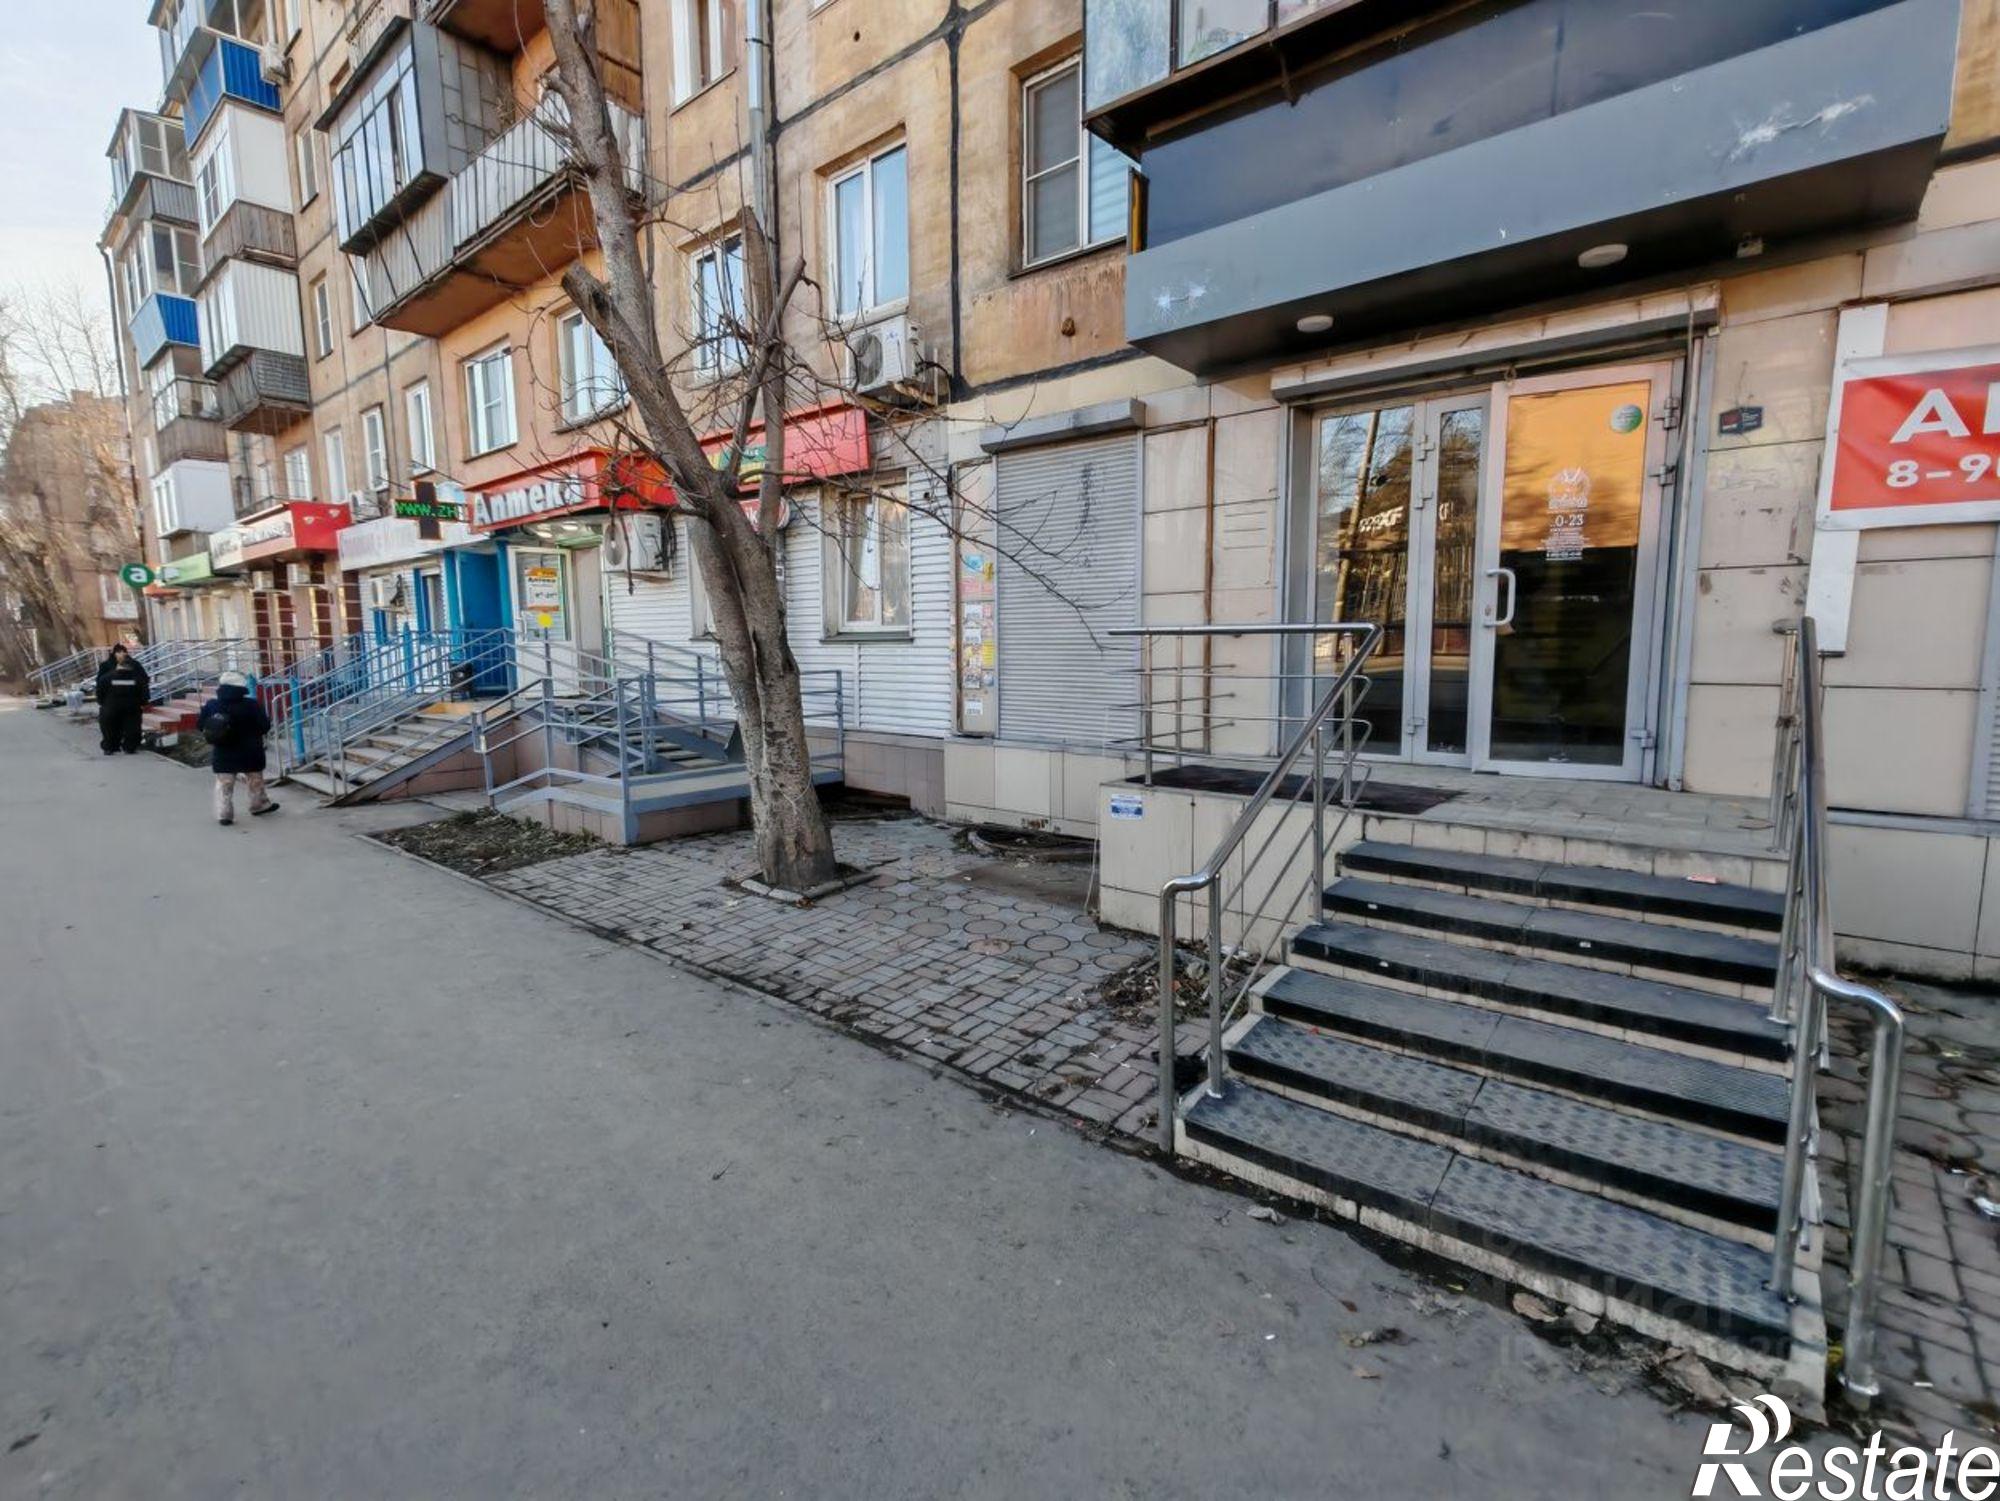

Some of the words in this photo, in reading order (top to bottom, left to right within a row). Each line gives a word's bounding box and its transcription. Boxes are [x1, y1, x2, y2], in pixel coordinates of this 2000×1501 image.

[1890, 382, 2000, 443] А
[1886, 453, 2000, 487] 8-9
[472, 474, 582, 526] Аптека
